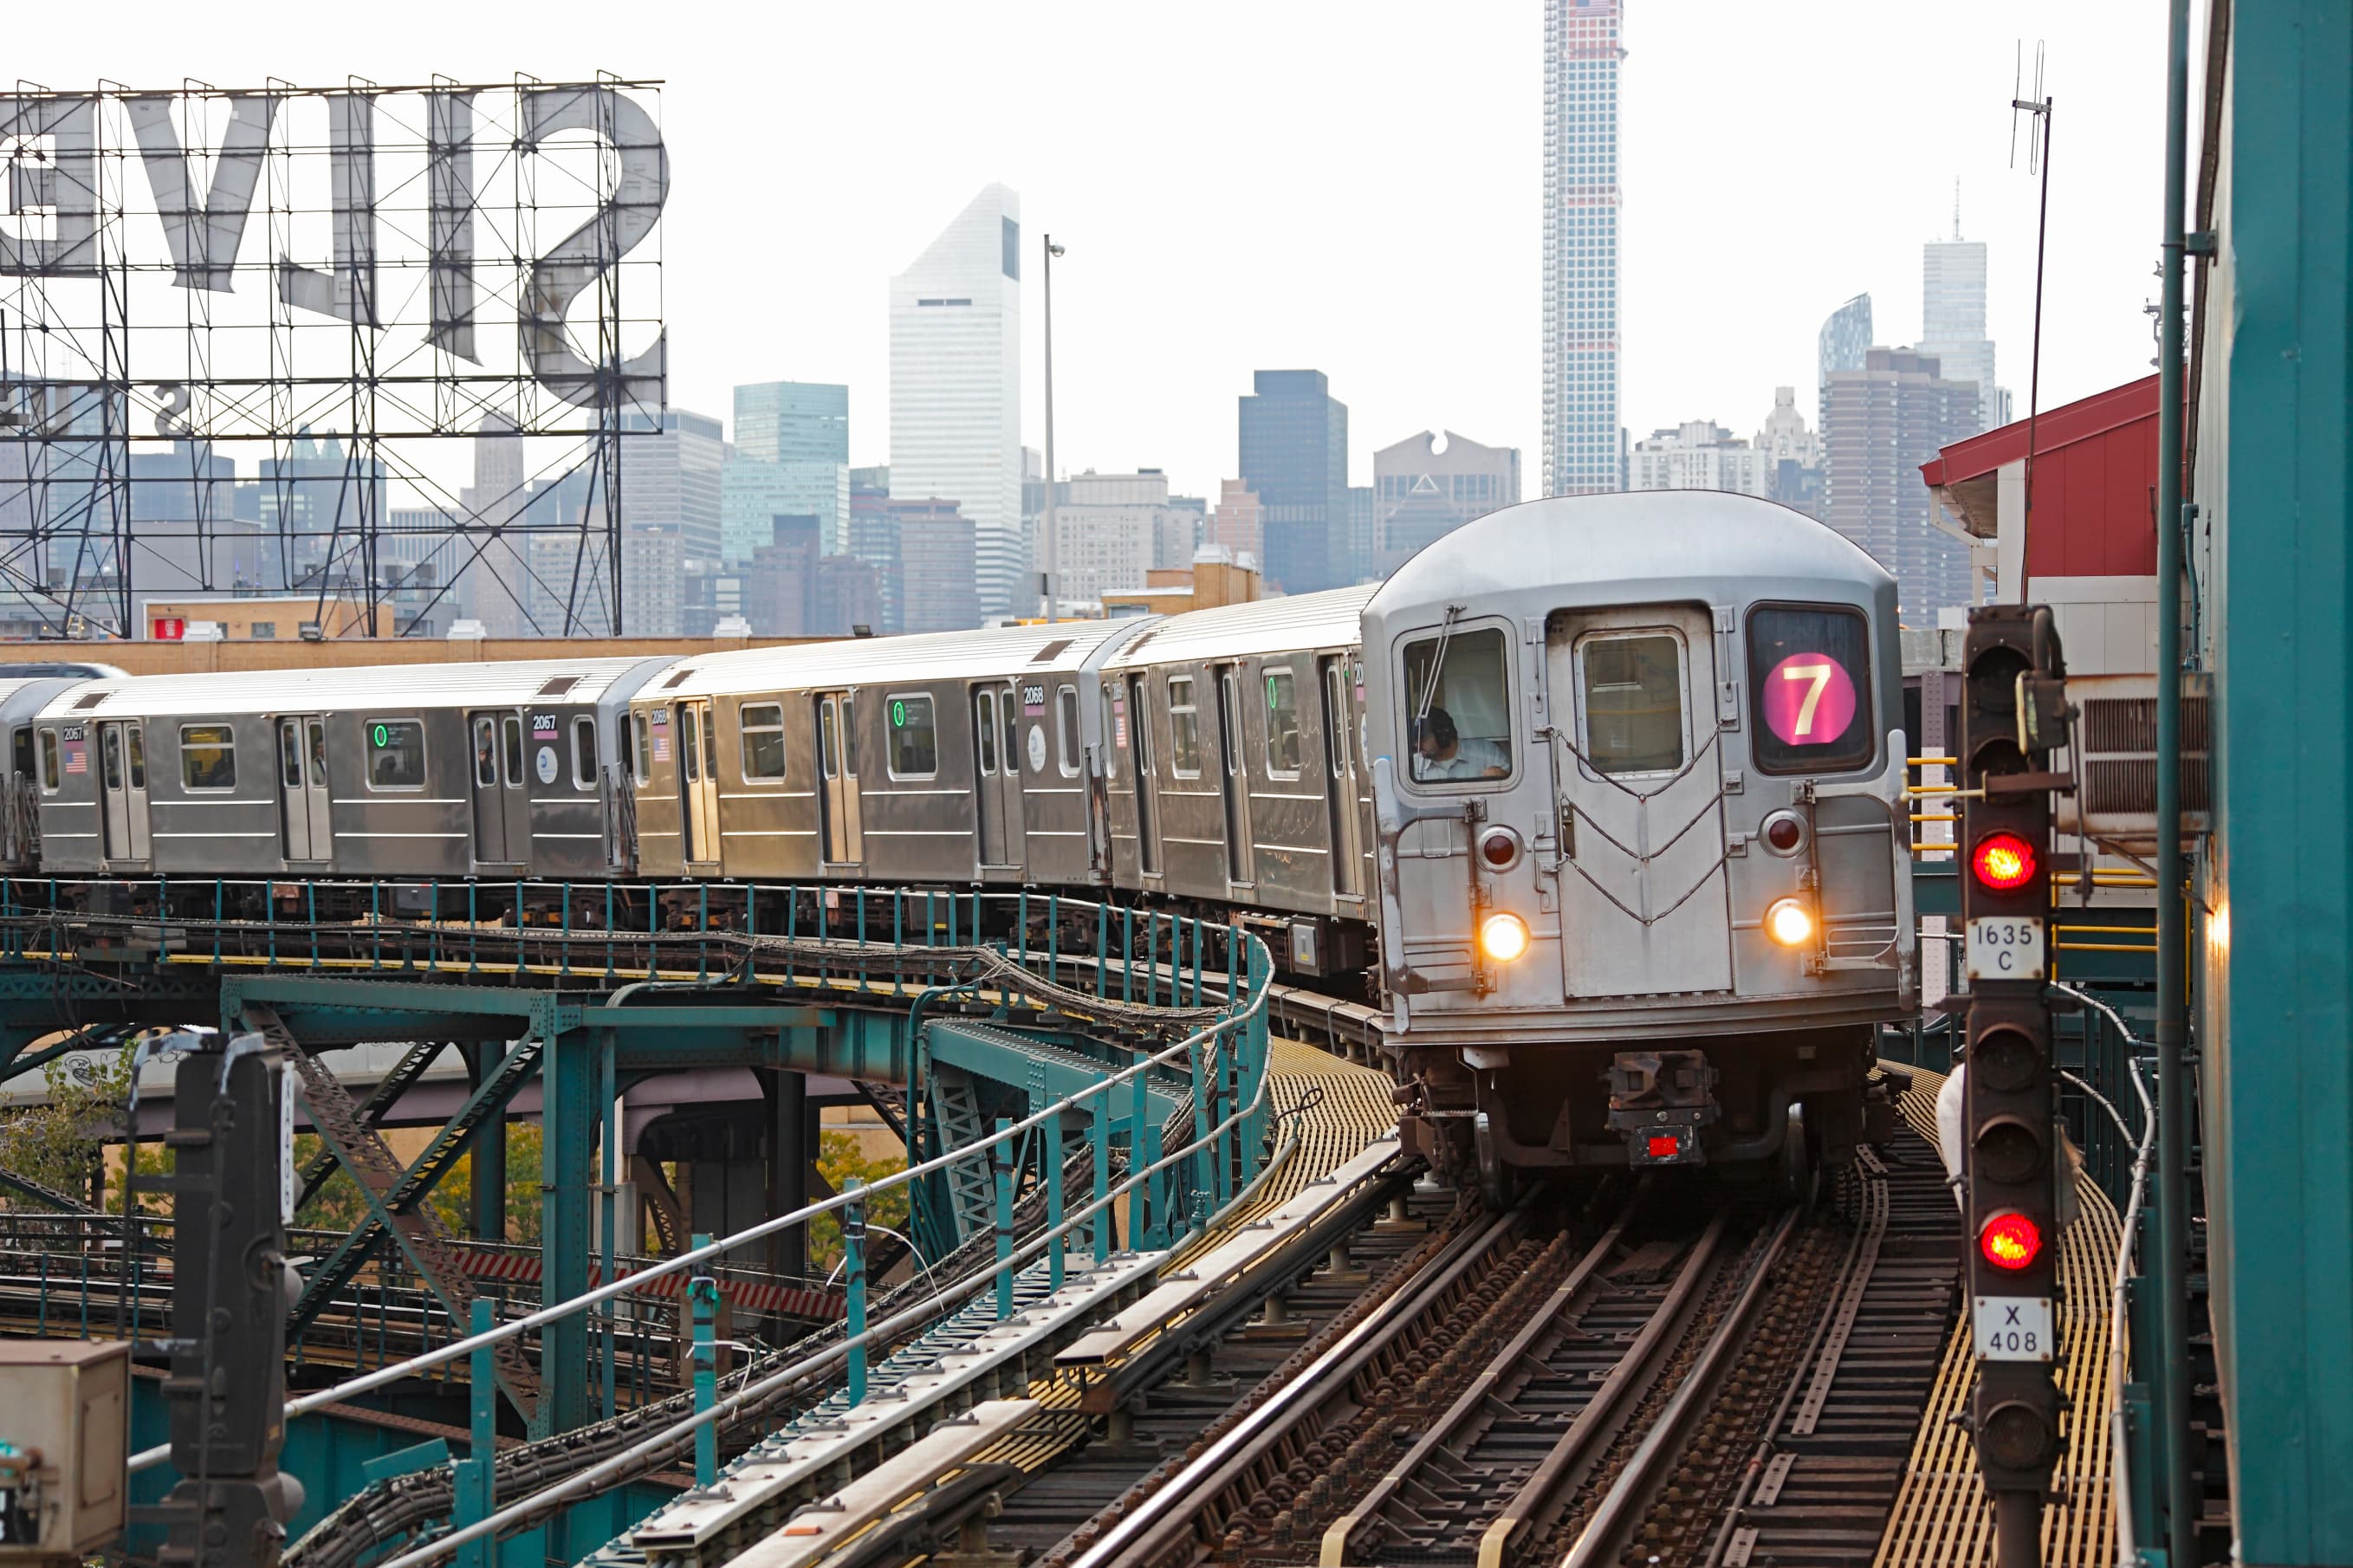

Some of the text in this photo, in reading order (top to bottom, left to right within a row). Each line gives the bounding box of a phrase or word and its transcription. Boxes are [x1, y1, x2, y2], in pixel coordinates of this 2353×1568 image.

[1024, 685, 1044, 705] 2068
[1783, 664, 1831, 735] 7
[533, 715, 556, 730] 2067
[651, 709, 666, 724] 2068
[64, 727, 83, 741] 2067
[1978, 924, 2032, 945] 1635
[1998, 950, 2013, 970] C
[2005, 1305, 2021, 1326] X
[1990, 1332, 2038, 1352] 408
